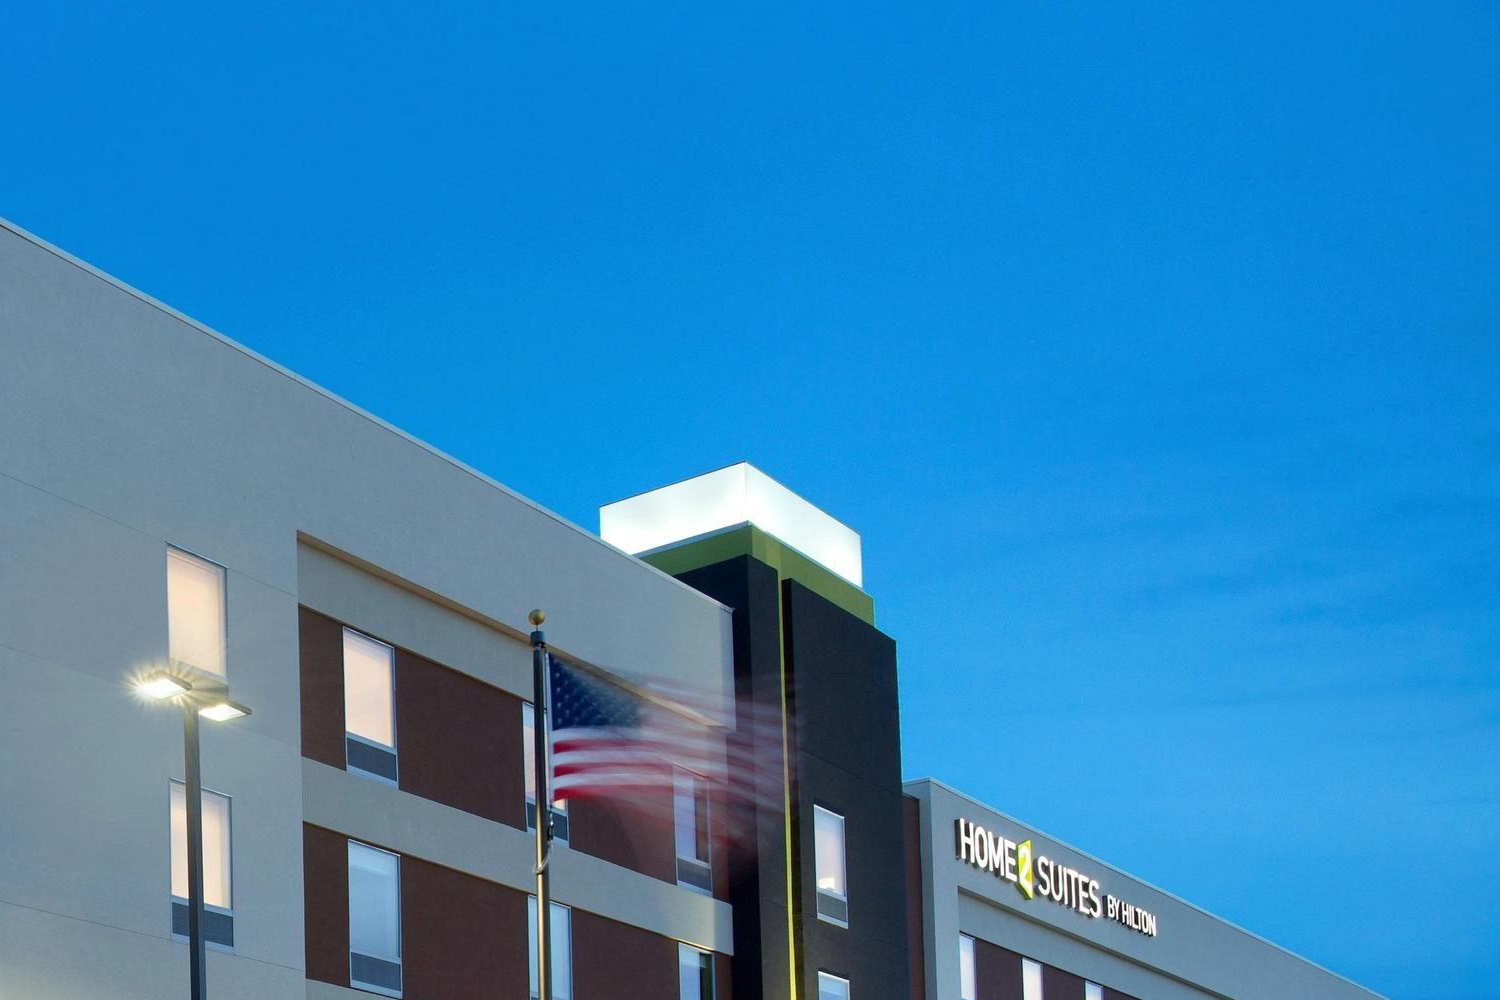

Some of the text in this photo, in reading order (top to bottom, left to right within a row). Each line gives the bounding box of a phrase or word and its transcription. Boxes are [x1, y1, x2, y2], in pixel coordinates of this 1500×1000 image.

[1037, 855, 1100, 918] SUITES
[1107, 894, 1120, 920] BY
[1122, 901, 1156, 937] HILTON
